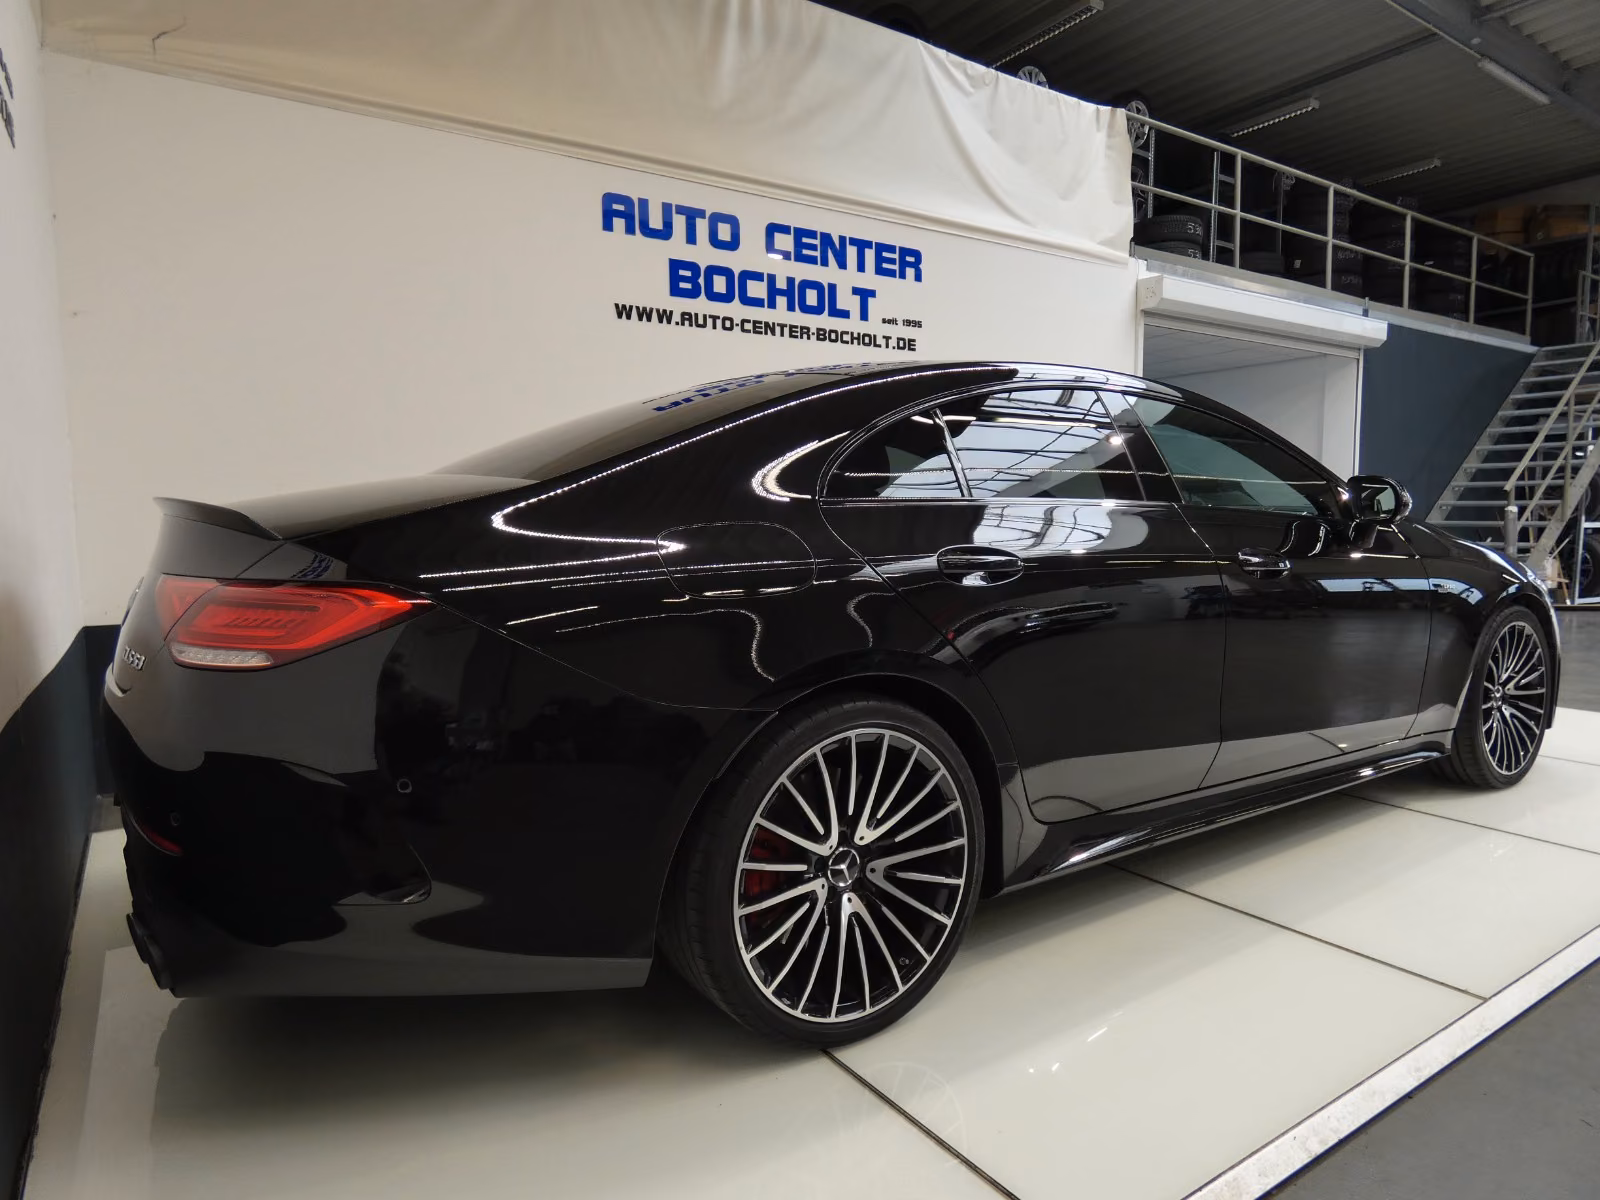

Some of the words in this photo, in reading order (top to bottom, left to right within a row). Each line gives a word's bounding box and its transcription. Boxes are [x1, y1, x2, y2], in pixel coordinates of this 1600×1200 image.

[602, 192, 740, 252] AUTO
[765, 222, 922, 282] CENTER
[668, 258, 876, 320] BOCHOLT
[614, 303, 916, 351] WWW.AUTO-CENTER-BOCHOLT.DE
[881, 317, 898, 326] seit
[902, 318, 922, 329] 1995
